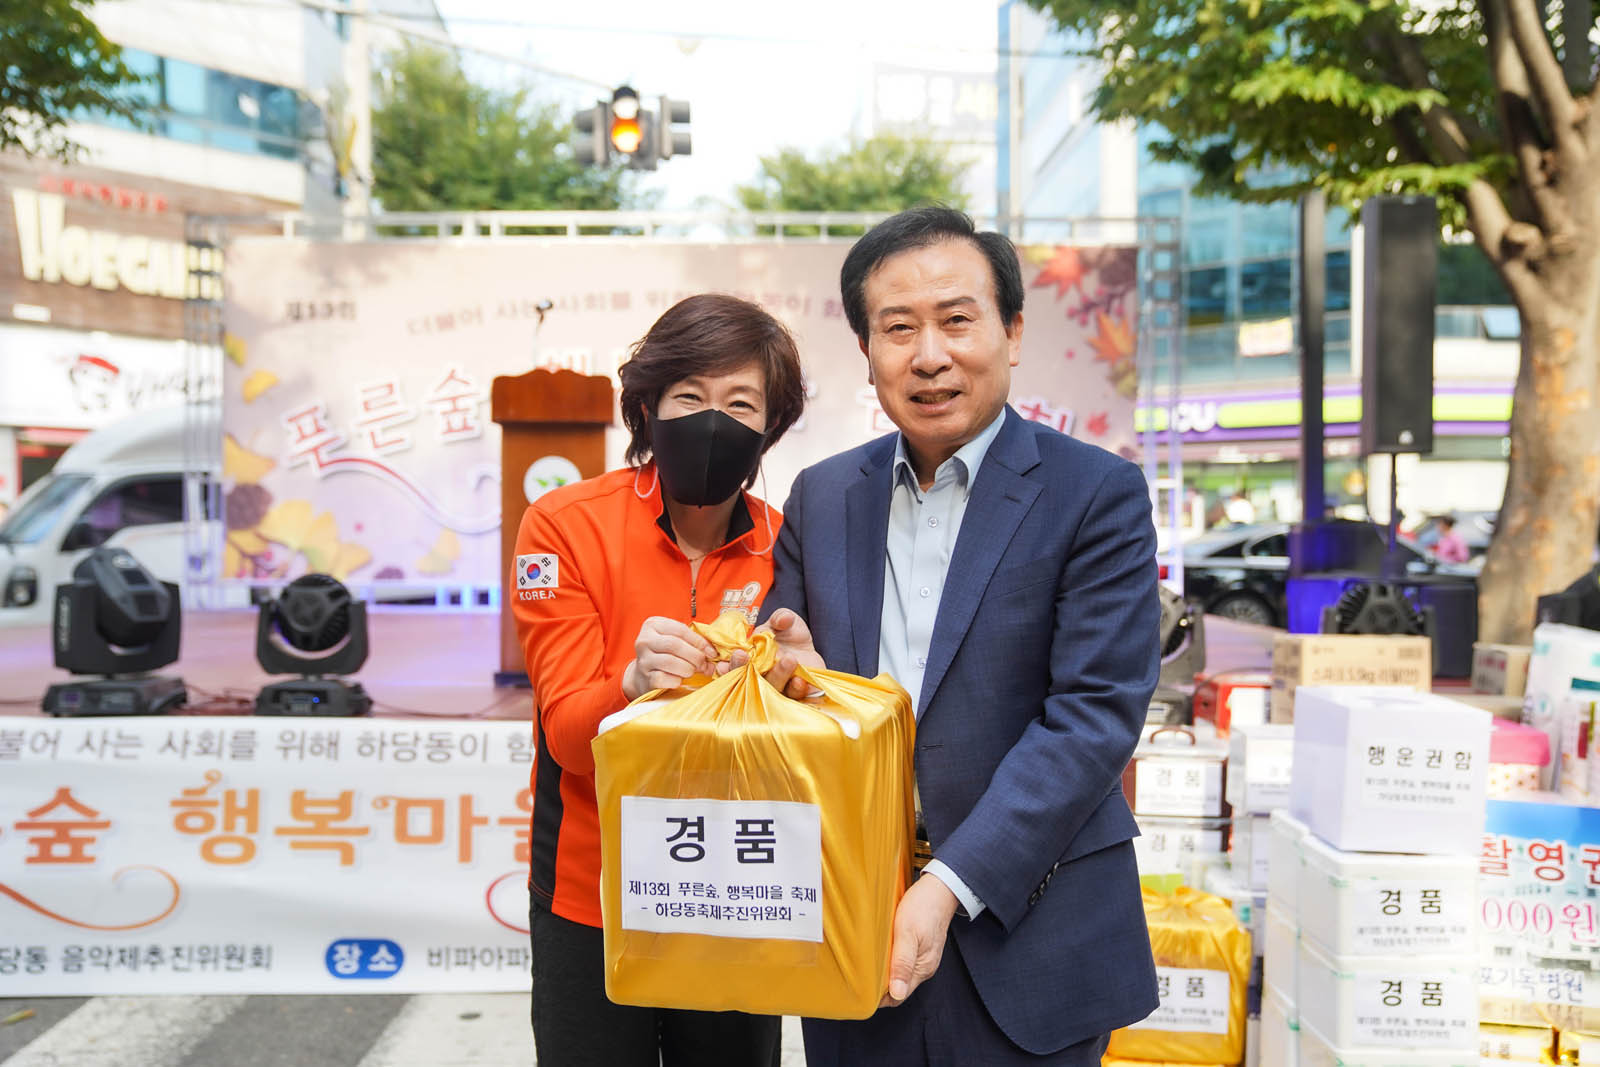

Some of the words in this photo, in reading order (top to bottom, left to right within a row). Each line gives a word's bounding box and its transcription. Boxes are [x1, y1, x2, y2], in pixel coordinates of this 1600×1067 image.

[287, 368, 482, 468] 푸른숲
[1171, 401, 1217, 432] CU
[519, 591, 556, 601] KOREA
[78, 730, 143, 760] 사는
[159, 730, 258, 761] 사회를
[275, 730, 340, 761] 위해
[356, 731, 489, 763] 하당동이
[628, 880, 671, 897] 제13회
[678, 882, 720, 899] 푸른숲,
[727, 885, 784, 901] 행복마을
[791, 886, 817, 903] 축제
[655, 902, 792, 922] 하당동축제추진위원회
